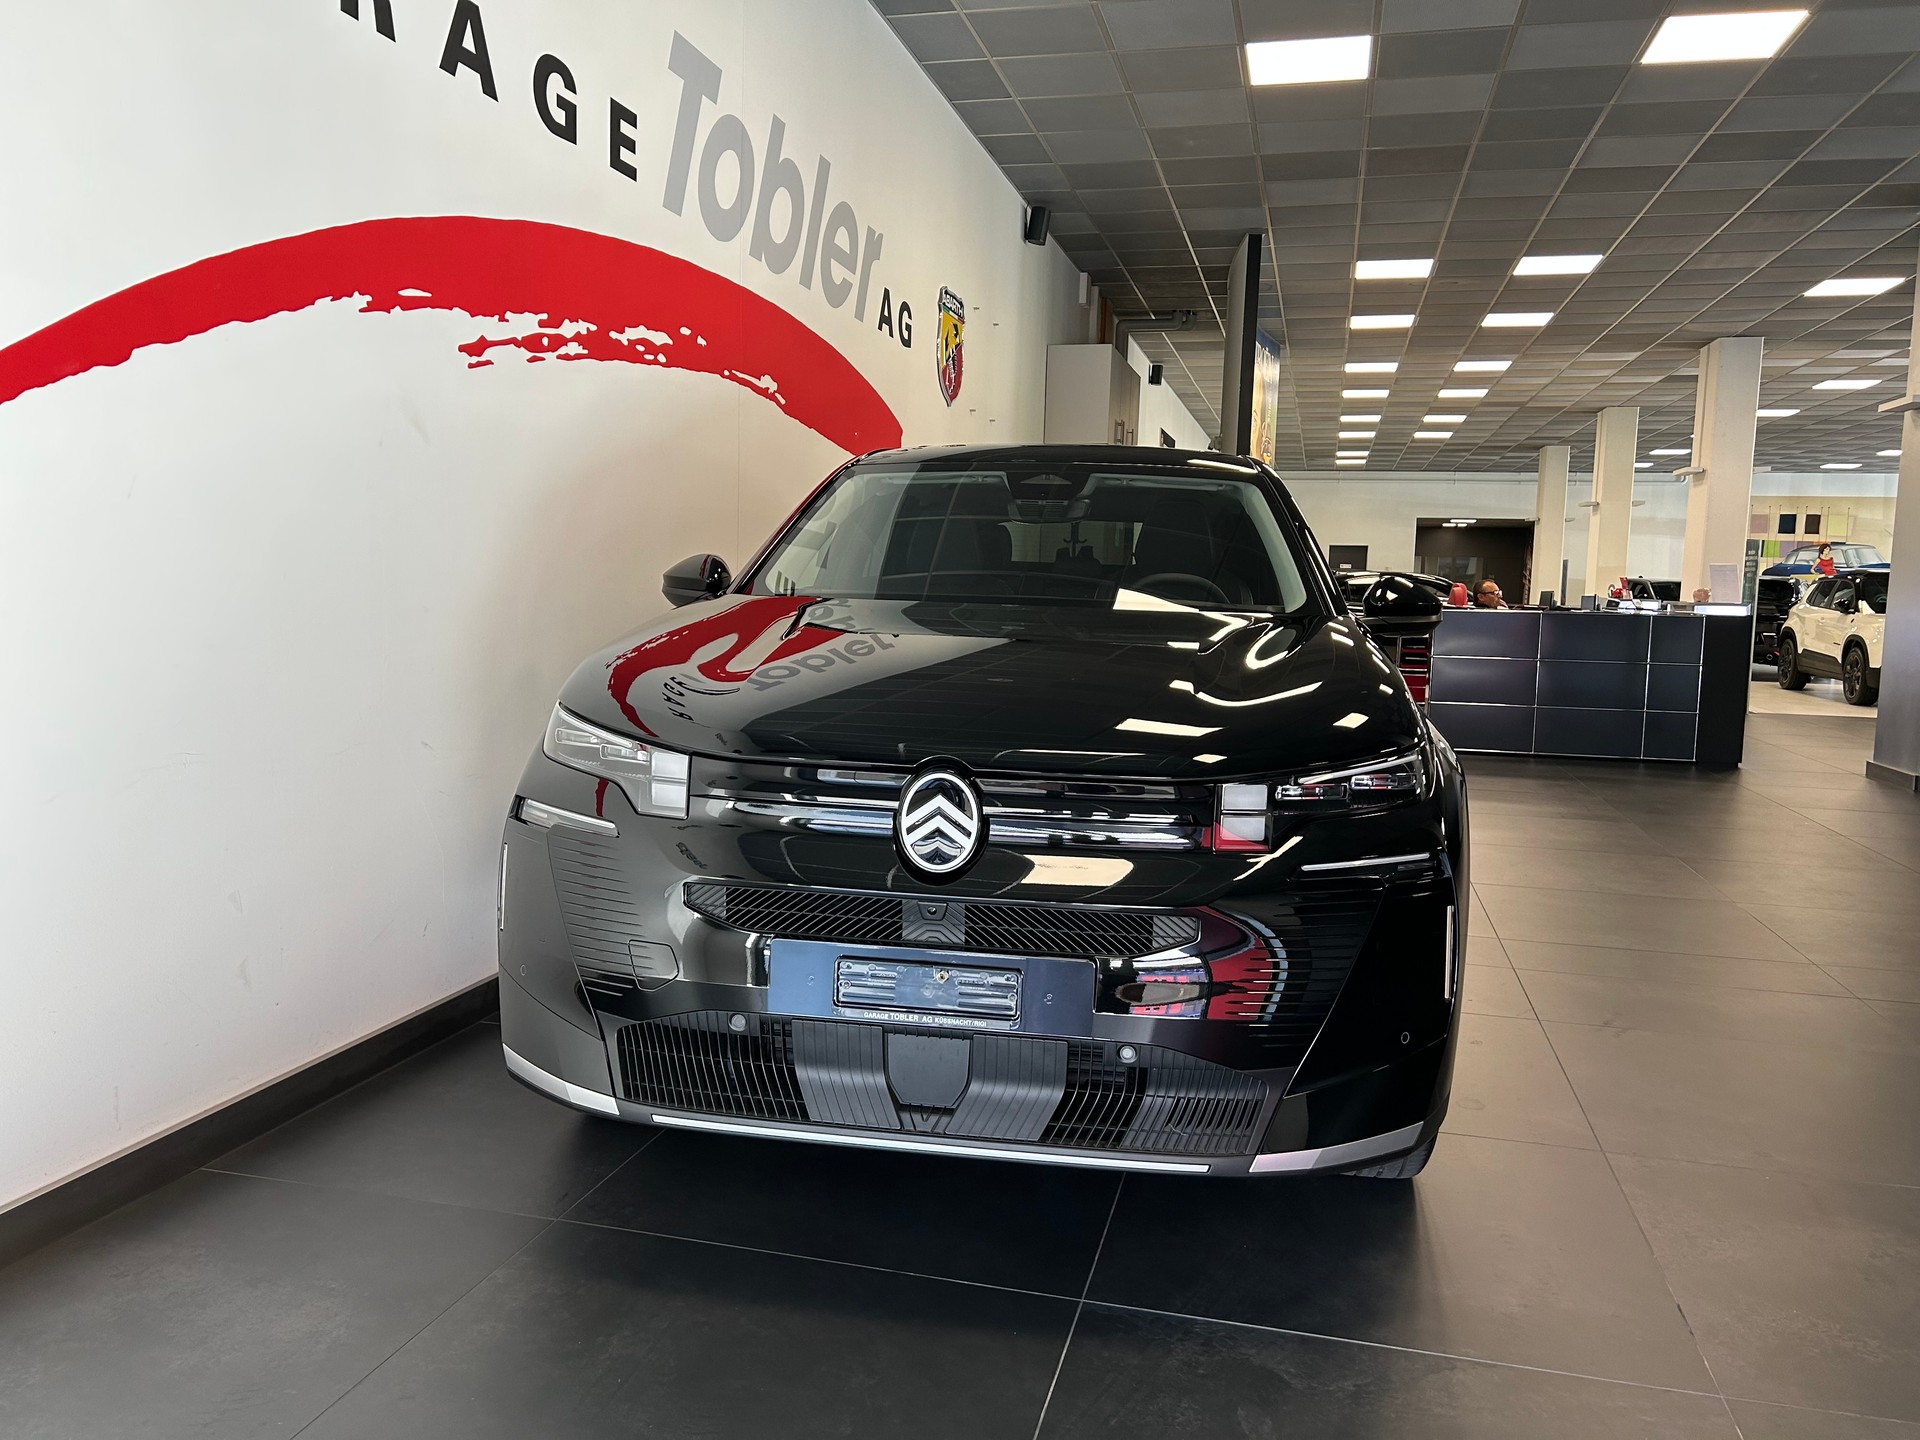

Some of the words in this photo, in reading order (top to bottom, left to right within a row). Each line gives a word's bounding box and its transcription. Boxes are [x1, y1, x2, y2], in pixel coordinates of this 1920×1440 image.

[663, 30, 884, 323] Tobler
[878, 287, 912, 348] AG
[943, 290, 964, 319] ABARTH
[863, 1011, 889, 1020] GARAGE
[890, 1012, 919, 1022] TOBLER
[921, 1015, 933, 1023] AG
